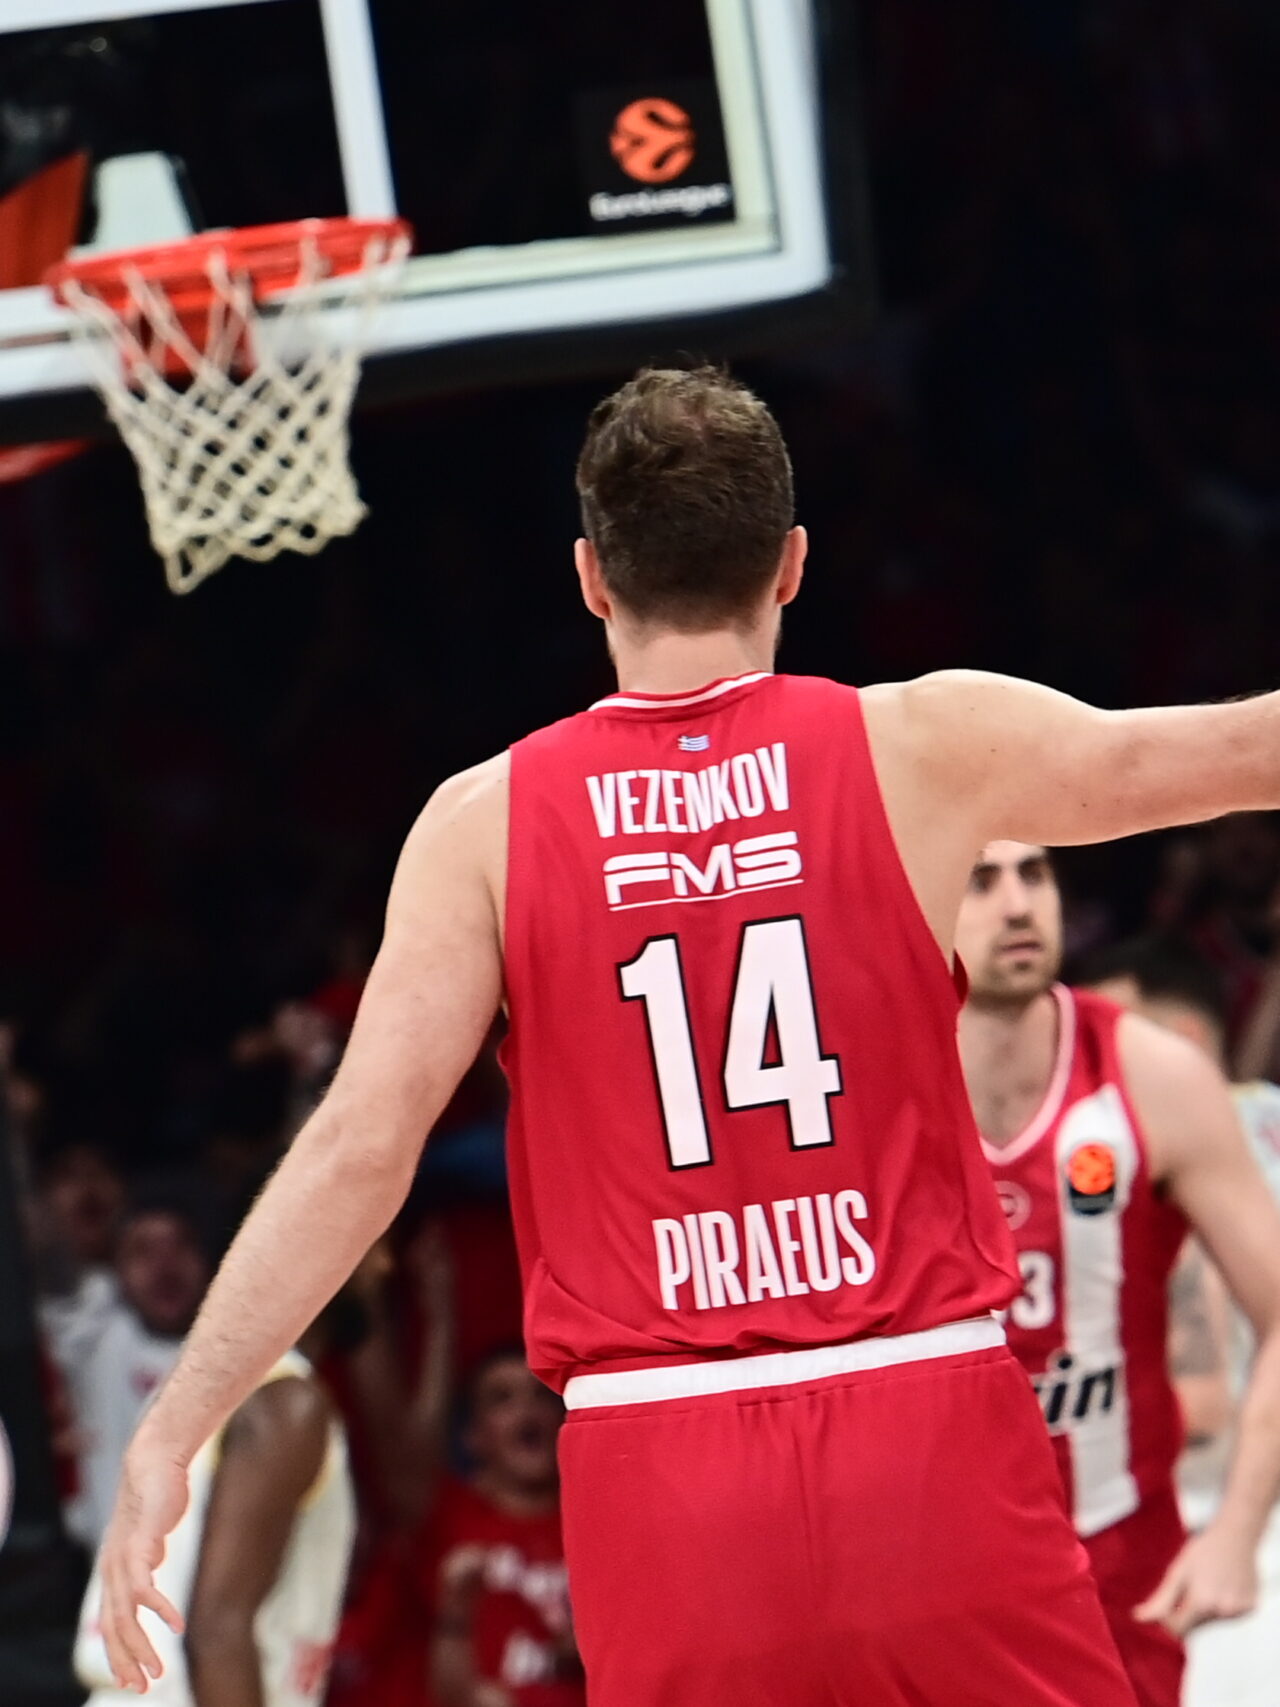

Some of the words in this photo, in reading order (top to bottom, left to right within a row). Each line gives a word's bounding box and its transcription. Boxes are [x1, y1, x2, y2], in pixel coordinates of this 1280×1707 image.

[585, 742, 790, 838] VEZENKOV
[603, 831, 802, 905] FMS
[616, 914, 844, 1172] 14
[652, 1189, 876, 1311] PIRAEUS
[1034, 1351, 1118, 1425] in
